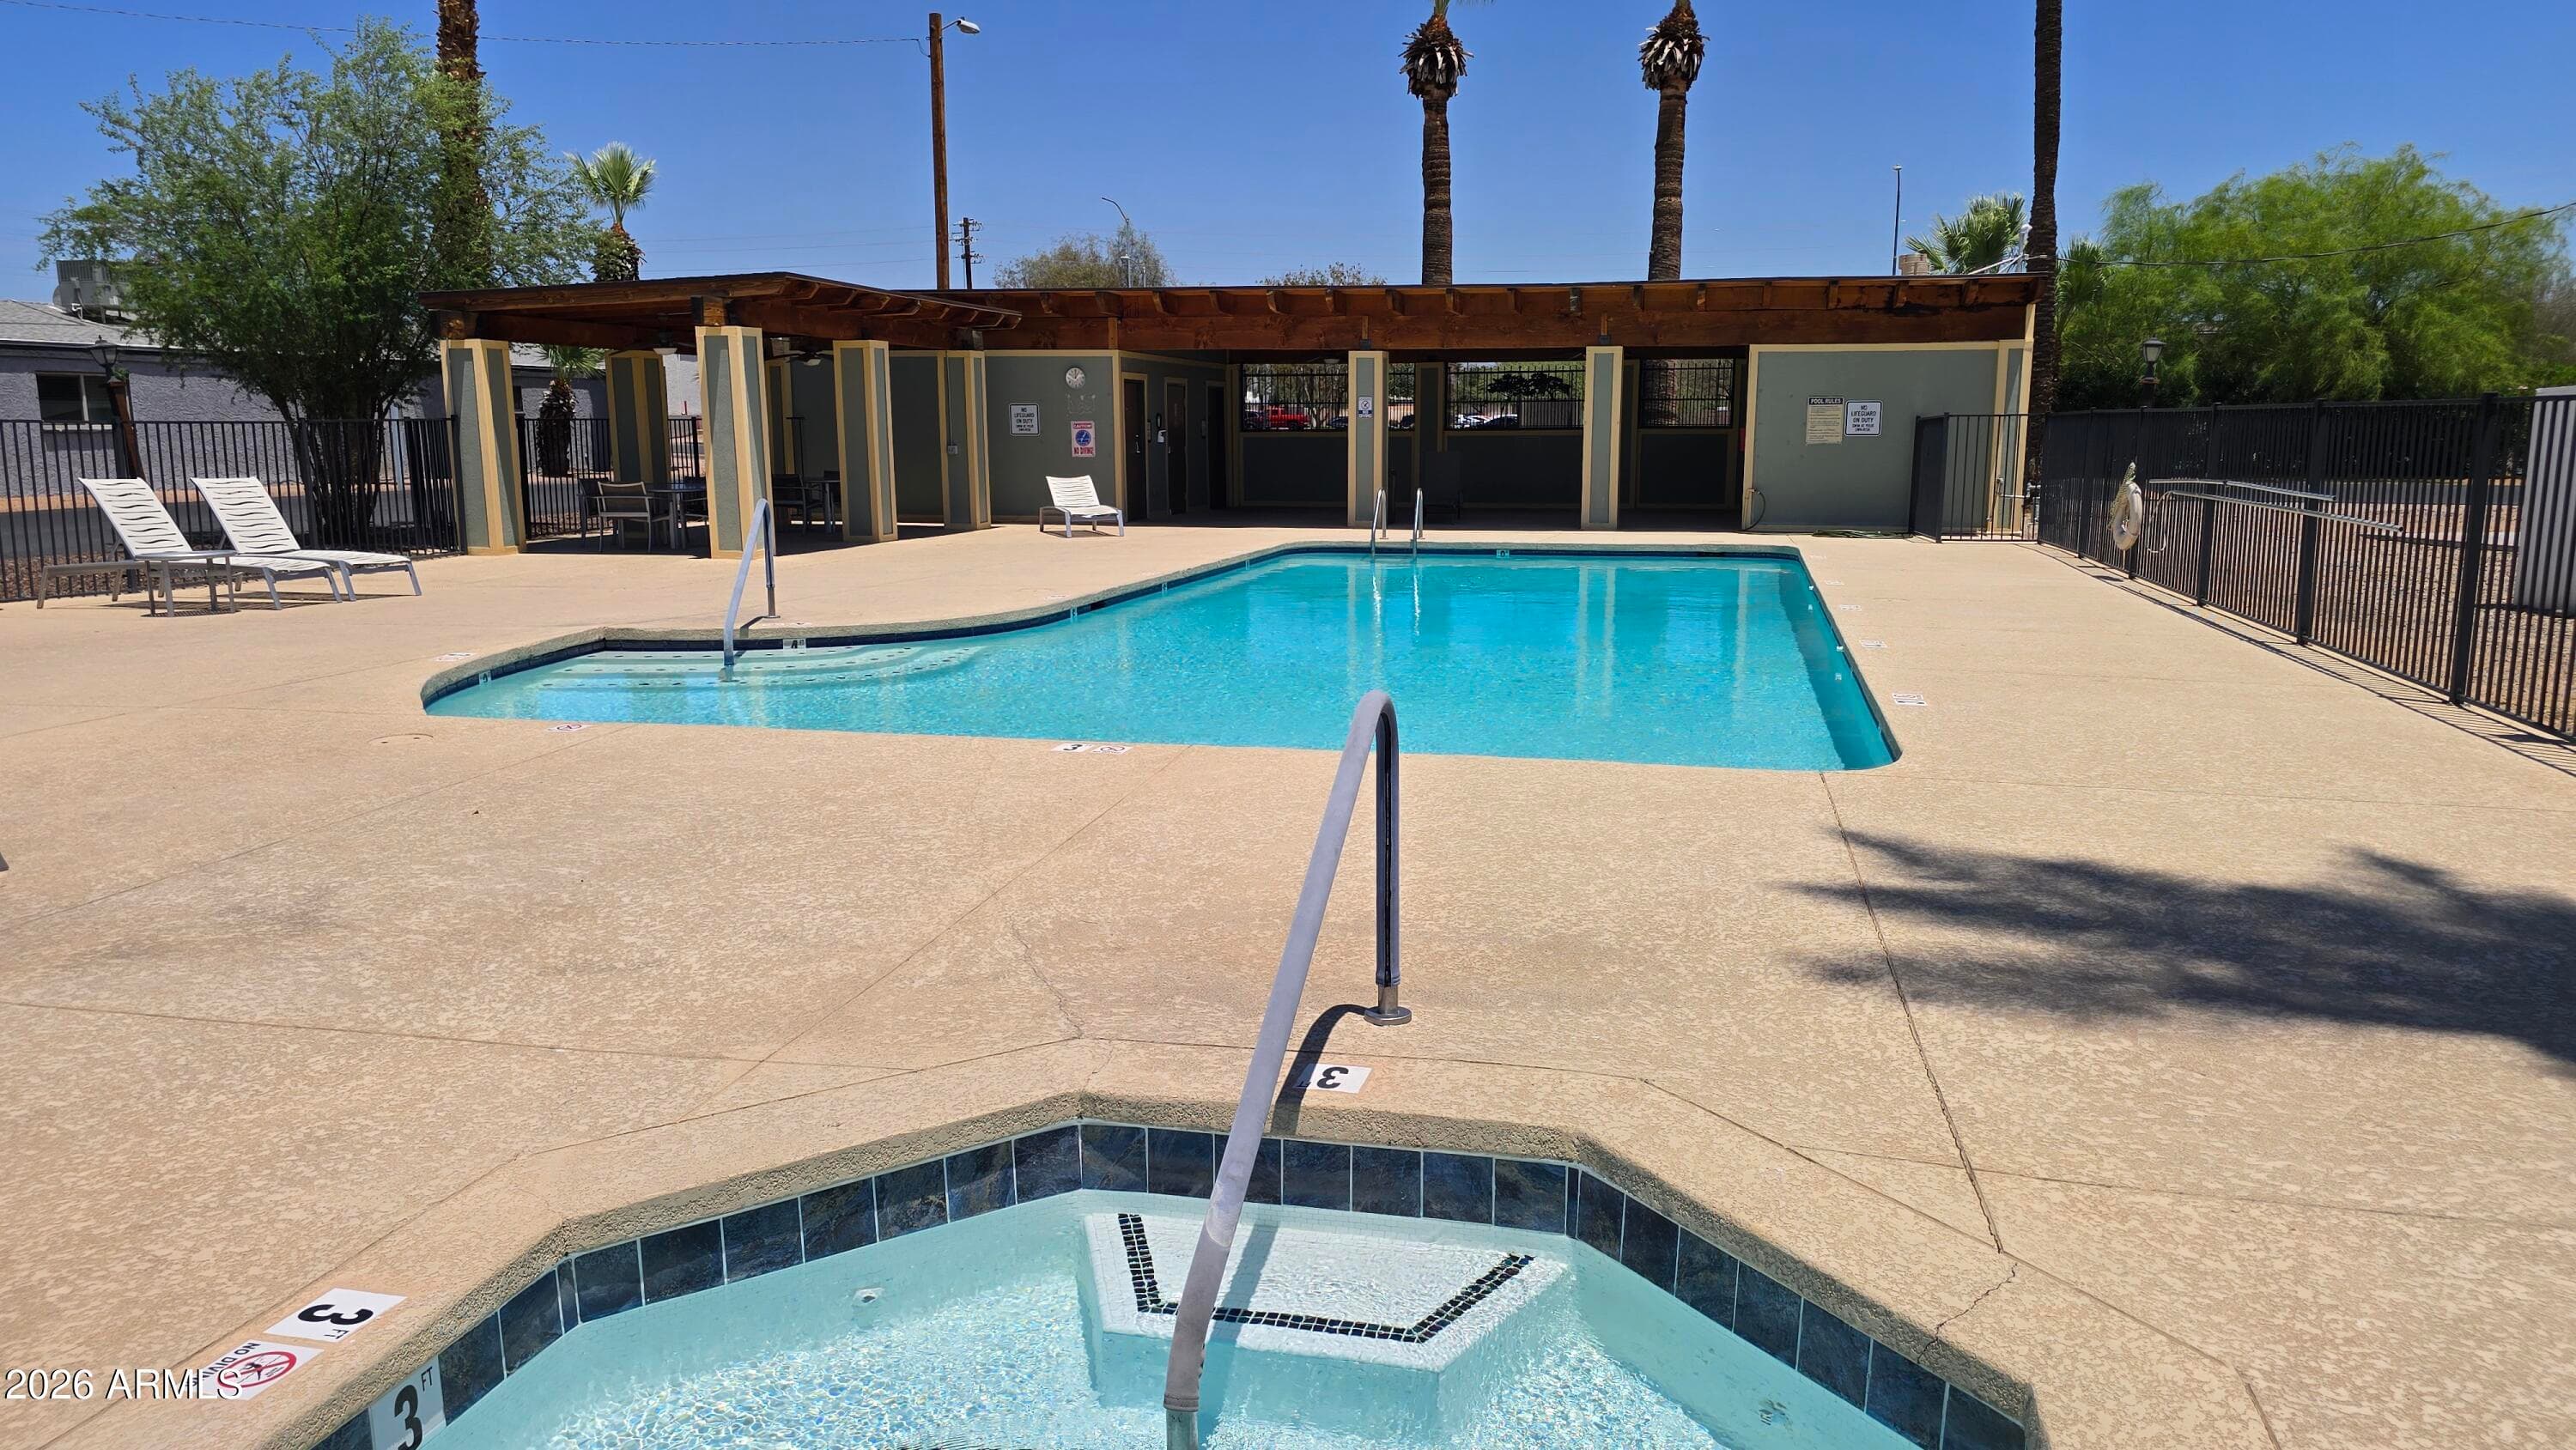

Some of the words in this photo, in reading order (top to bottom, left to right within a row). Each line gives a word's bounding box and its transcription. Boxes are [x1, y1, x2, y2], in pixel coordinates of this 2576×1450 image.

[1317, 1067, 1349, 1089] 3
[298, 1304, 374, 1326] 3
[324, 1328, 350, 1339] FT
[234, 1343, 261, 1355] NO
[394, 1385, 422, 1450] 3
[421, 1367, 433, 1392] FT
